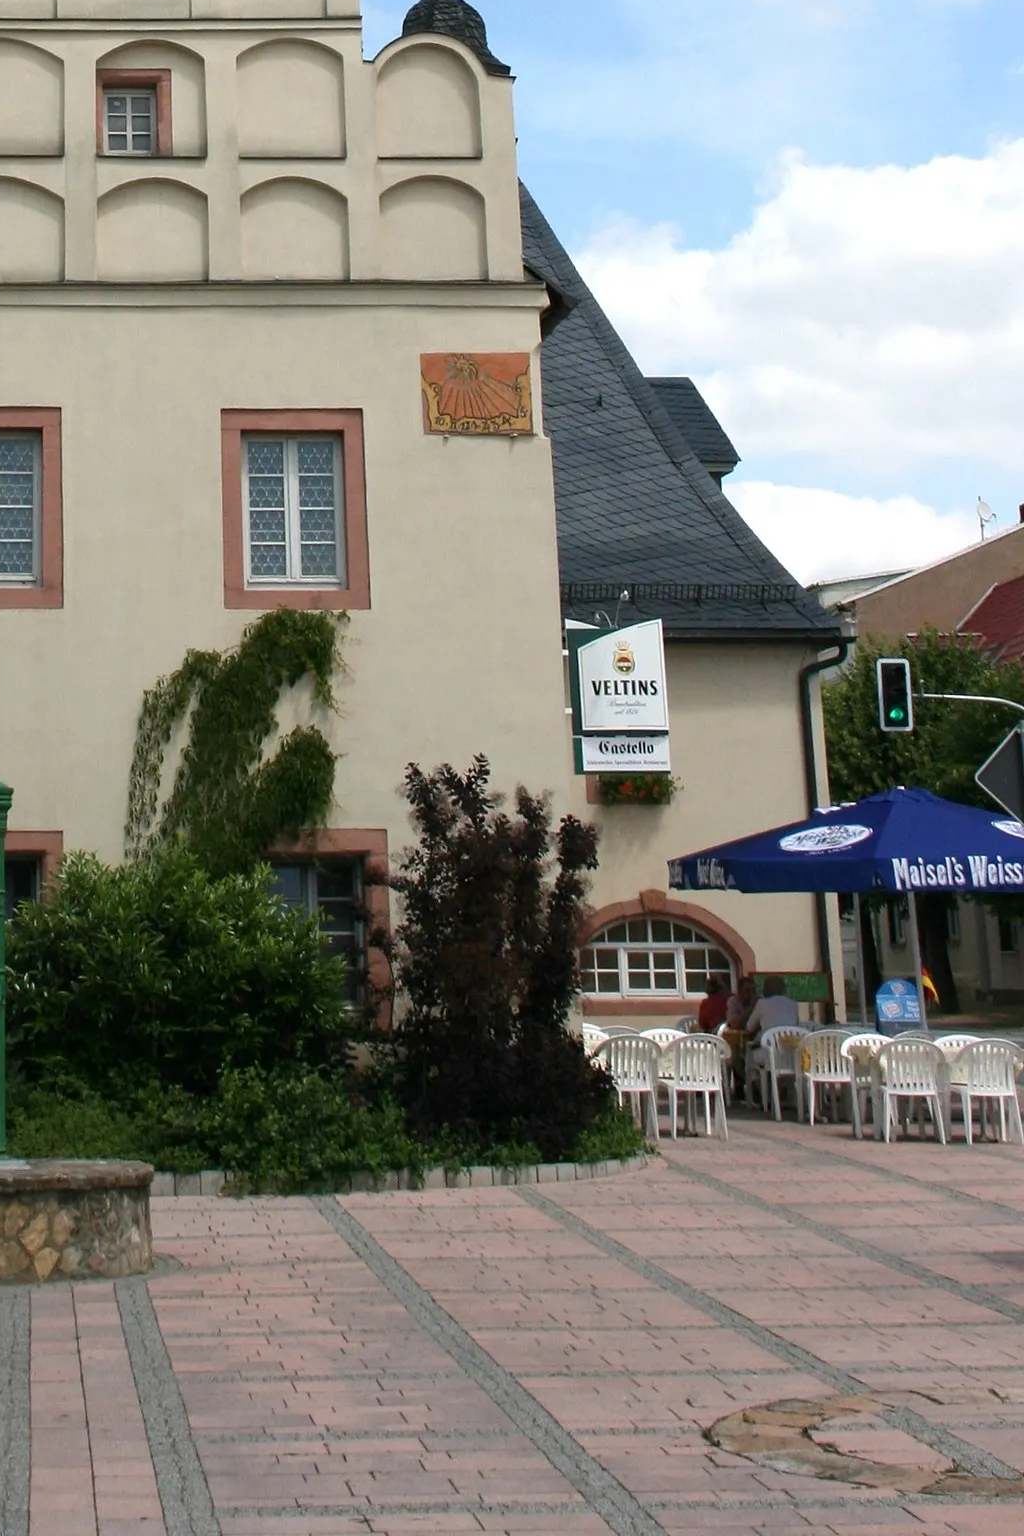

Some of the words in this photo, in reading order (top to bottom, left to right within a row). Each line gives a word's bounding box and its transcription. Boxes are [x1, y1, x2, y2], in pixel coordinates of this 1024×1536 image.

[592, 680, 658, 695] VELTINS
[599, 740, 654, 754] Castello
[891, 856, 967, 891] Maisel's
[967, 854, 1024, 888] Weiss
